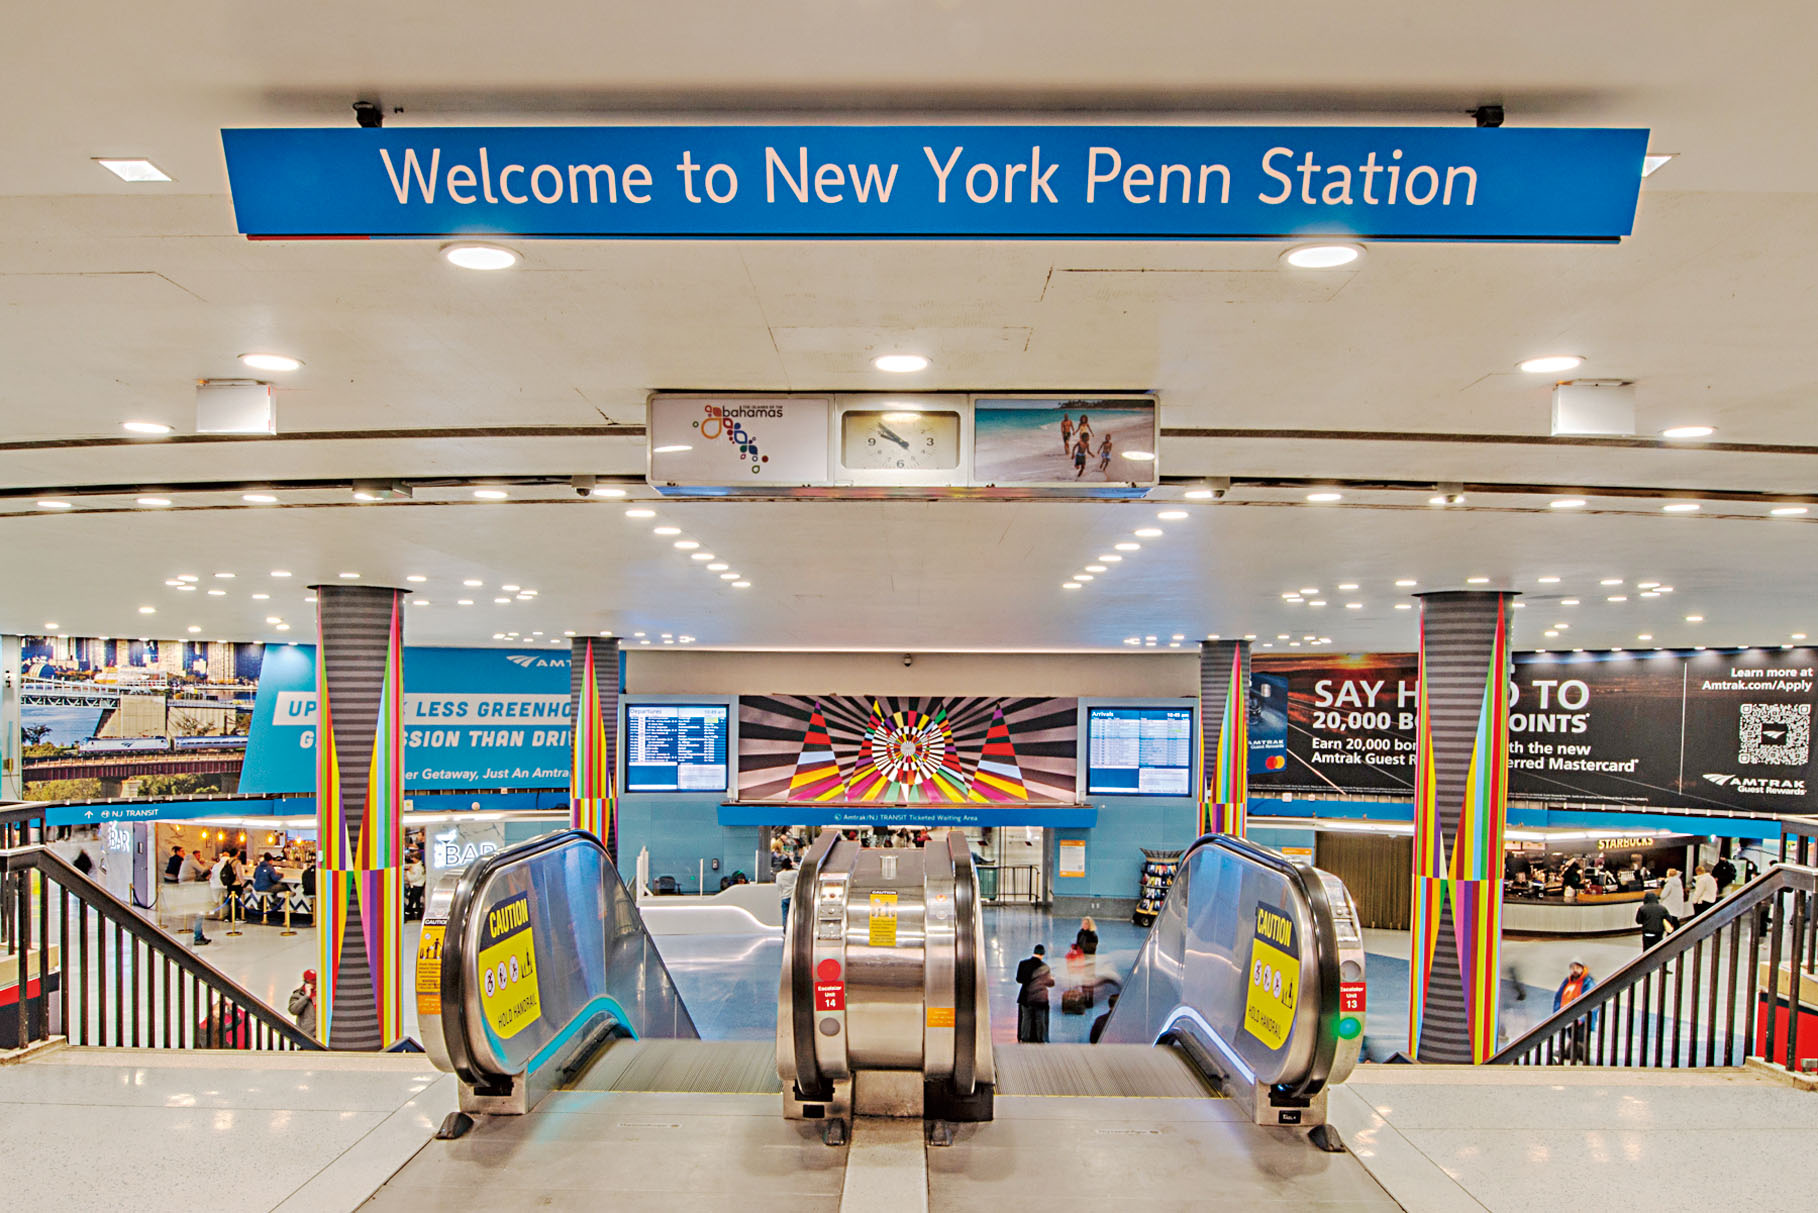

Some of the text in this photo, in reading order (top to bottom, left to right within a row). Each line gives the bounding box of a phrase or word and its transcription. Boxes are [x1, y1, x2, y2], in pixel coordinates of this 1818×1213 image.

[380, 146, 1478, 206] Welcome to New York Penn Station
[722, 405, 783, 417] bahamas
[926, 437, 935, 447] 3
[536, 659, 572, 667] AMT
[1731, 667, 1813, 677] Learn more at
[1702, 680, 1812, 692] Amtrak.com/Apply
[1314, 680, 1385, 708] SAY
[1532, 680, 1590, 710] TO
[288, 701, 316, 717] UP
[416, 701, 468, 717] LESS
[477, 701, 571, 717] GREENHO
[1312, 711, 1391, 731] 20,000
[1509, 713, 1590, 733] OINTS
[404, 731, 571, 747] SION THAN DRI
[1312, 738, 1342, 750] Earn
[1346, 738, 1391, 751] 20,000
[1508, 741, 1591, 755] th the new
[1311, 752, 1361, 764] Amtrak
[1365, 753, 1405, 765] Guest
[1508, 757, 1545, 769] erred
[405, 768, 570, 781] er Getaway, Just An Amtra
[1729, 778, 1805, 788] AMTRAK
[126, 809, 159, 817] TRANSIT
[937, 814, 961, 822] Waiting
[1598, 837, 1654, 850] STARBUCKS
[489, 898, 529, 938] CAUTION
[1256, 909, 1293, 948] CAUTION
[825, 999, 836, 1008] 14
[1346, 1000, 1358, 1008] 13
[498, 1009, 513, 1029] HOLD
